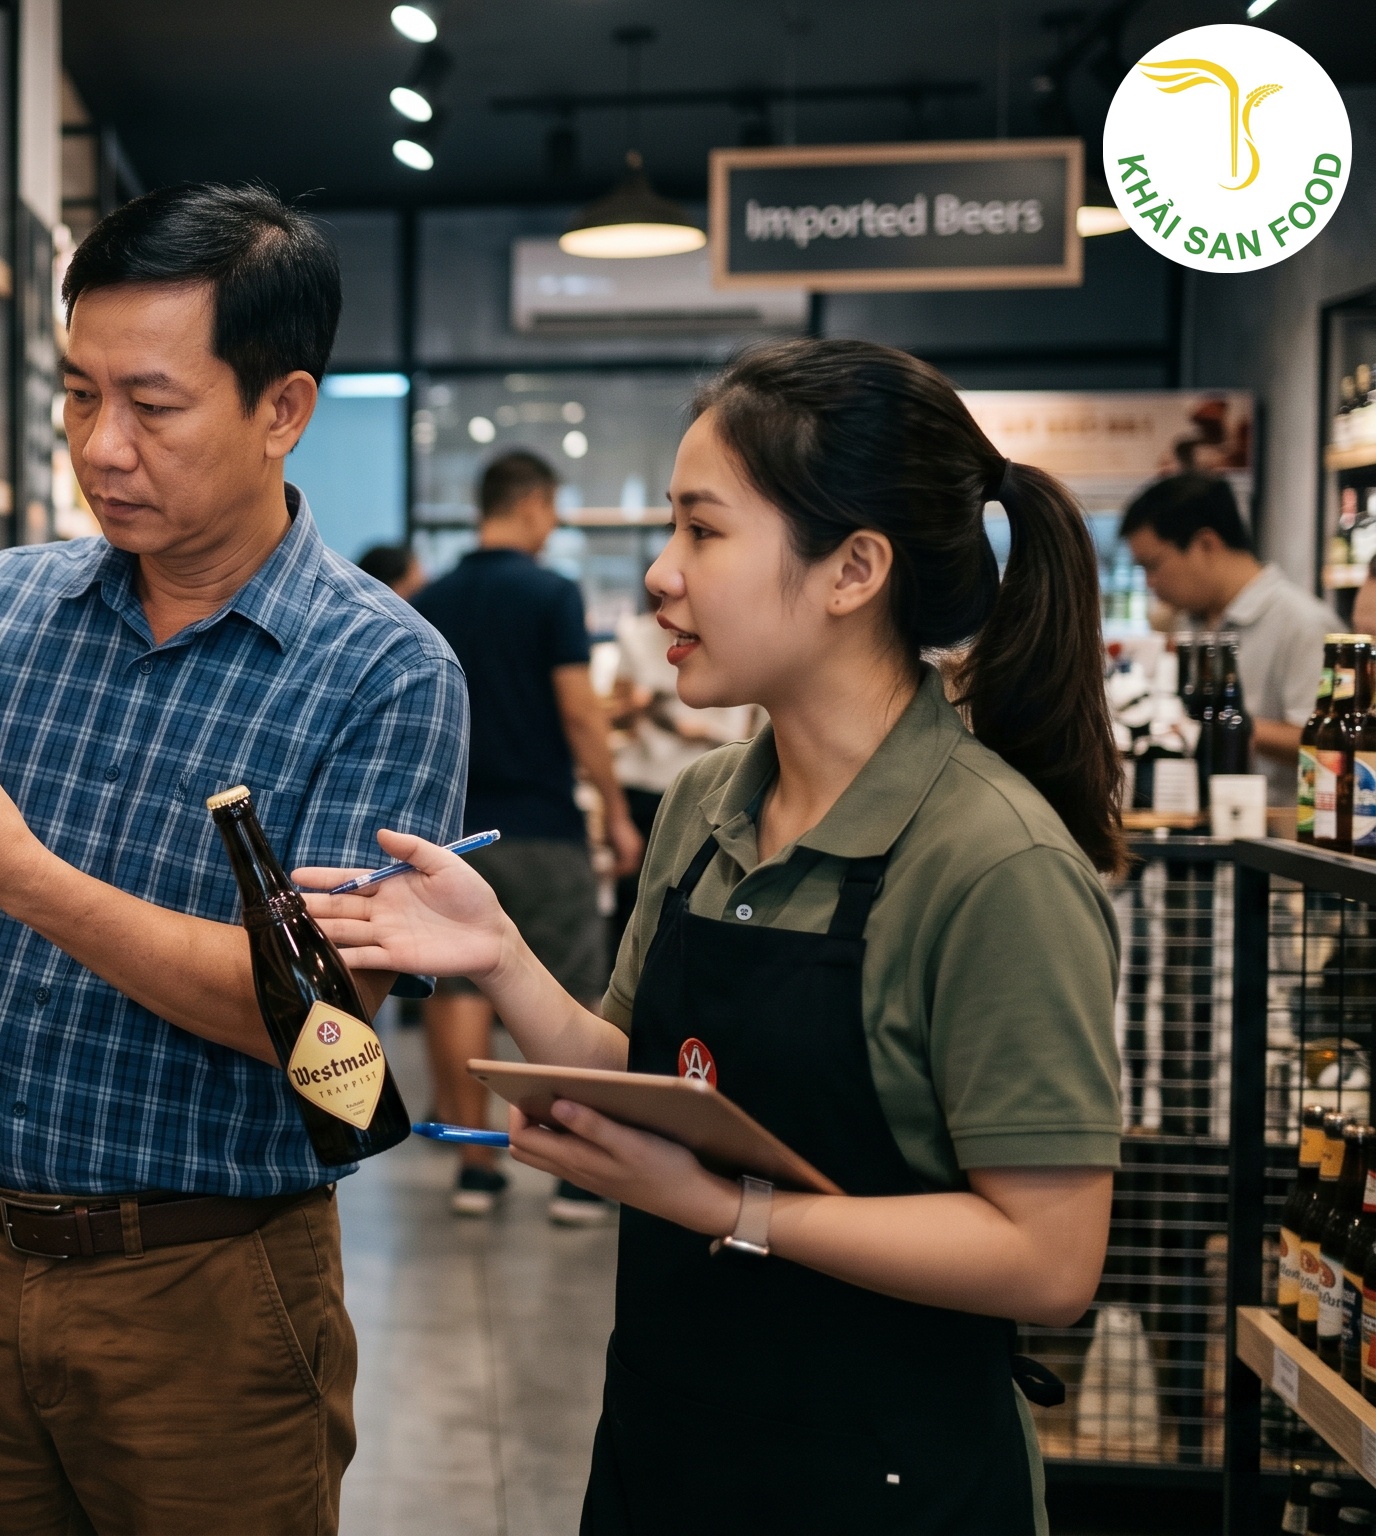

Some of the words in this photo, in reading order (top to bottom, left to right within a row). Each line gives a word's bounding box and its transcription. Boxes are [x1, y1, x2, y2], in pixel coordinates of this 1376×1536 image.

[745, 194, 927, 249] Imported
[934, 193, 1044, 236] Beers
[291, 1040, 382, 1087] Westmalle
[319, 1070, 377, 1098] TRAPPIST
